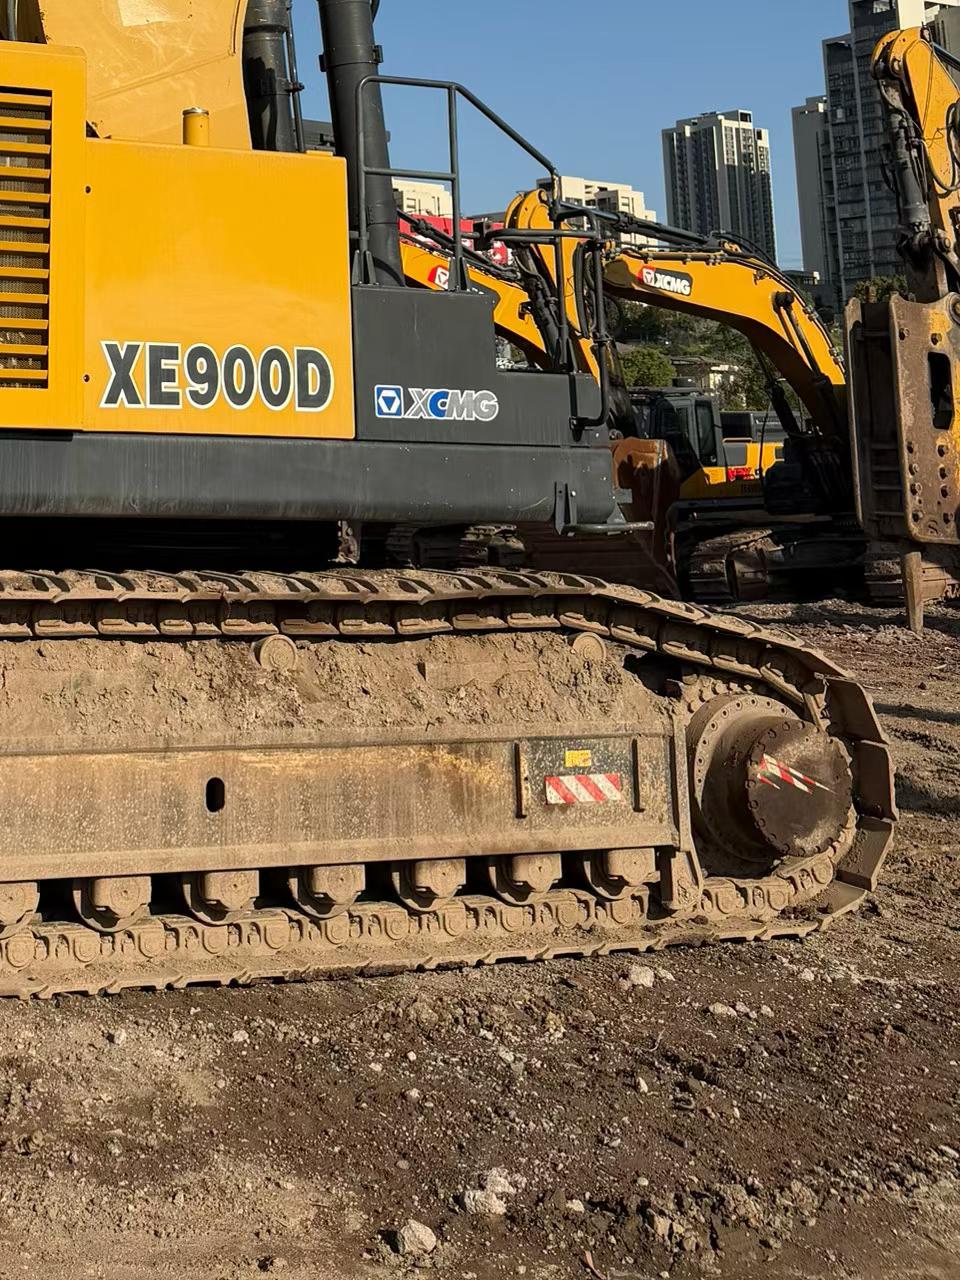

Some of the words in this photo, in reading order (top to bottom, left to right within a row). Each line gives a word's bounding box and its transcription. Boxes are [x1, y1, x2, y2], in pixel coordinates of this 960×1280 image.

[655, 273, 690, 295] XCMG
[100, 341, 334, 412] XE900D
[405, 387, 499, 422] XCMG
